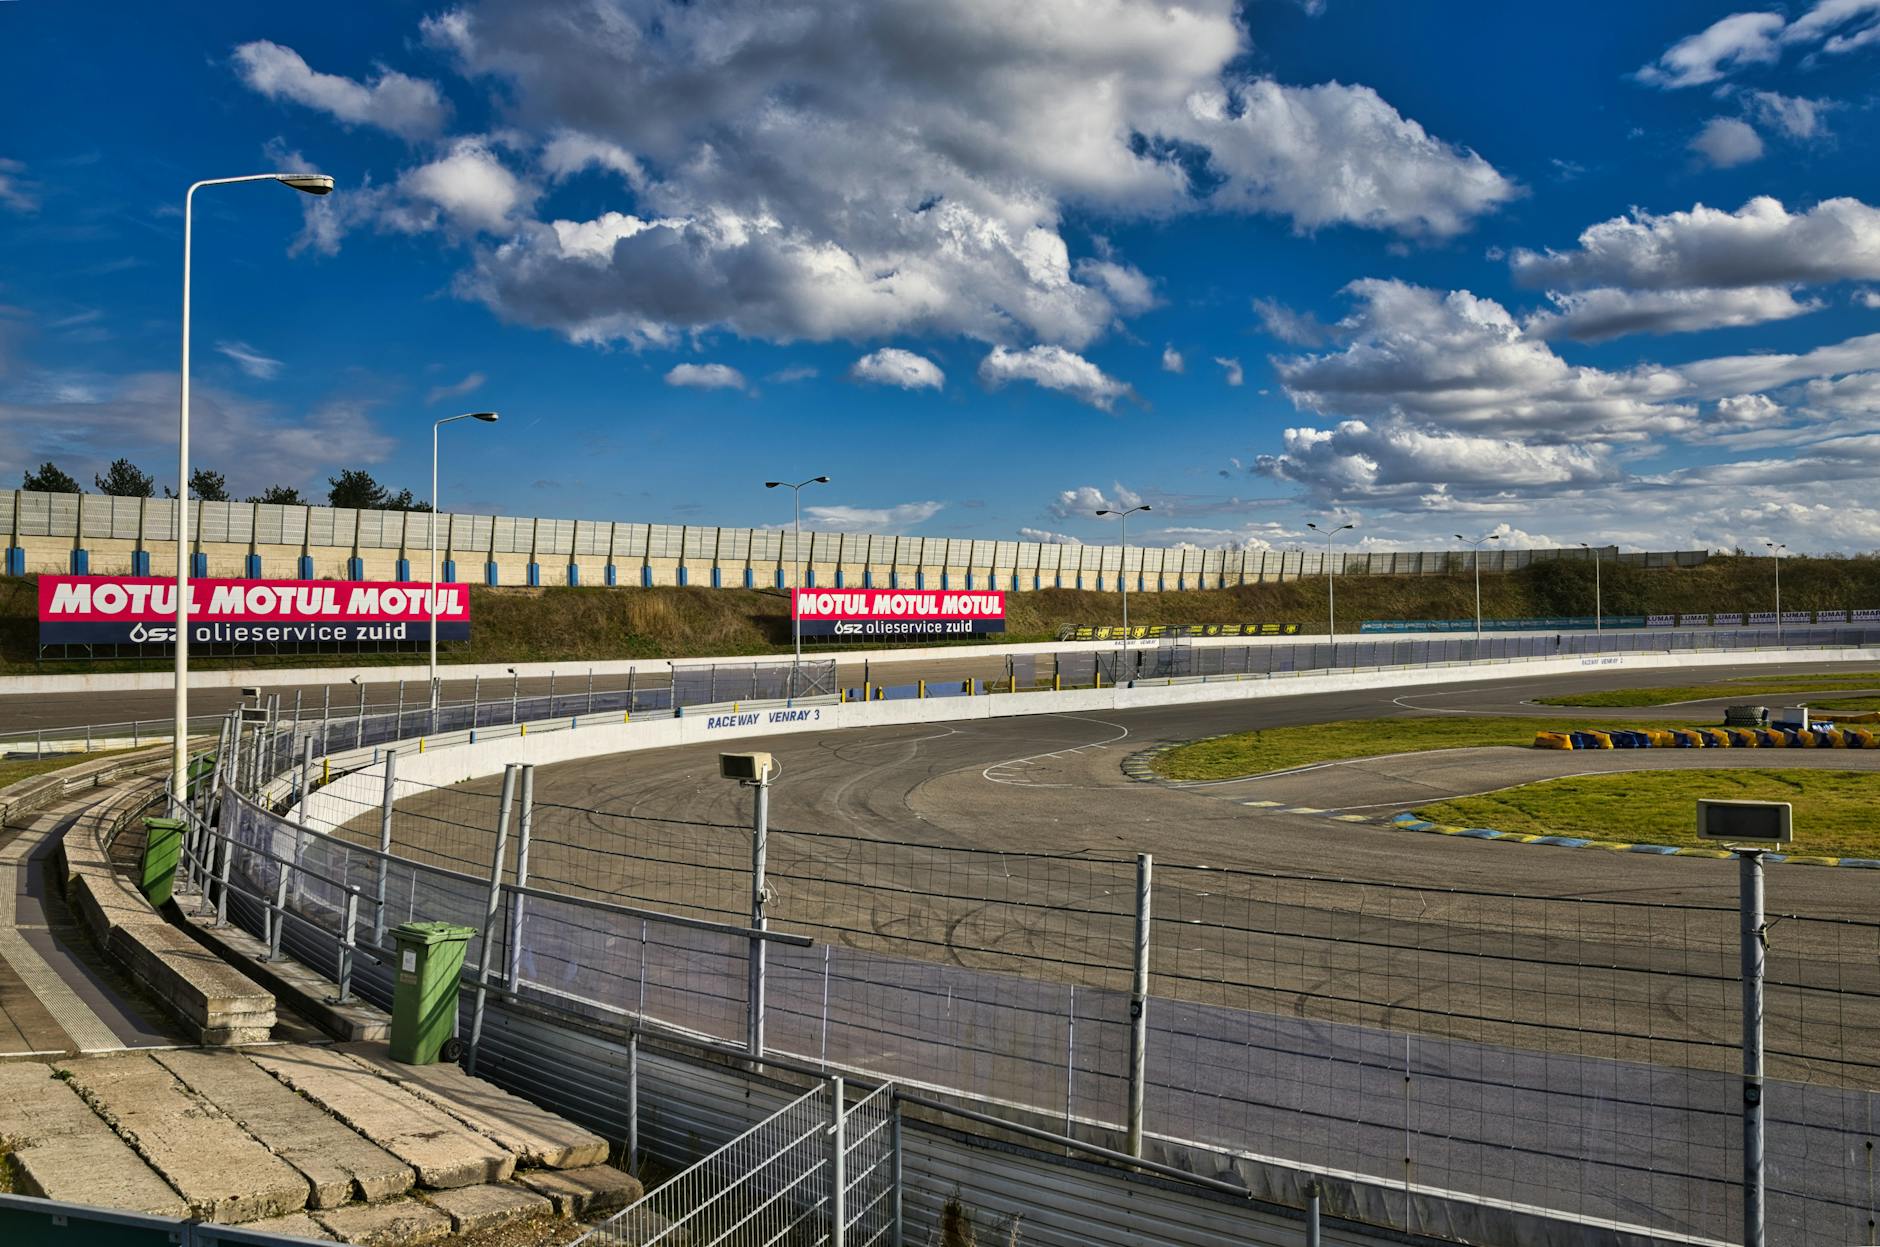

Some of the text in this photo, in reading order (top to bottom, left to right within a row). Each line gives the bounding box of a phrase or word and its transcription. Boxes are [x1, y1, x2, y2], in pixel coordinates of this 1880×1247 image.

[49, 583, 464, 616] MOTUL MOTUL MOTUL
[798, 593, 1002, 615] MOTUL MOTUL MOTUL
[196, 622, 347, 642] olieservice
[356, 621, 406, 640] zuid
[866, 620, 942, 634] olieservice
[946, 619, 972, 633] zuid
[707, 709, 820, 730] RACEWAY VENRAY 3
